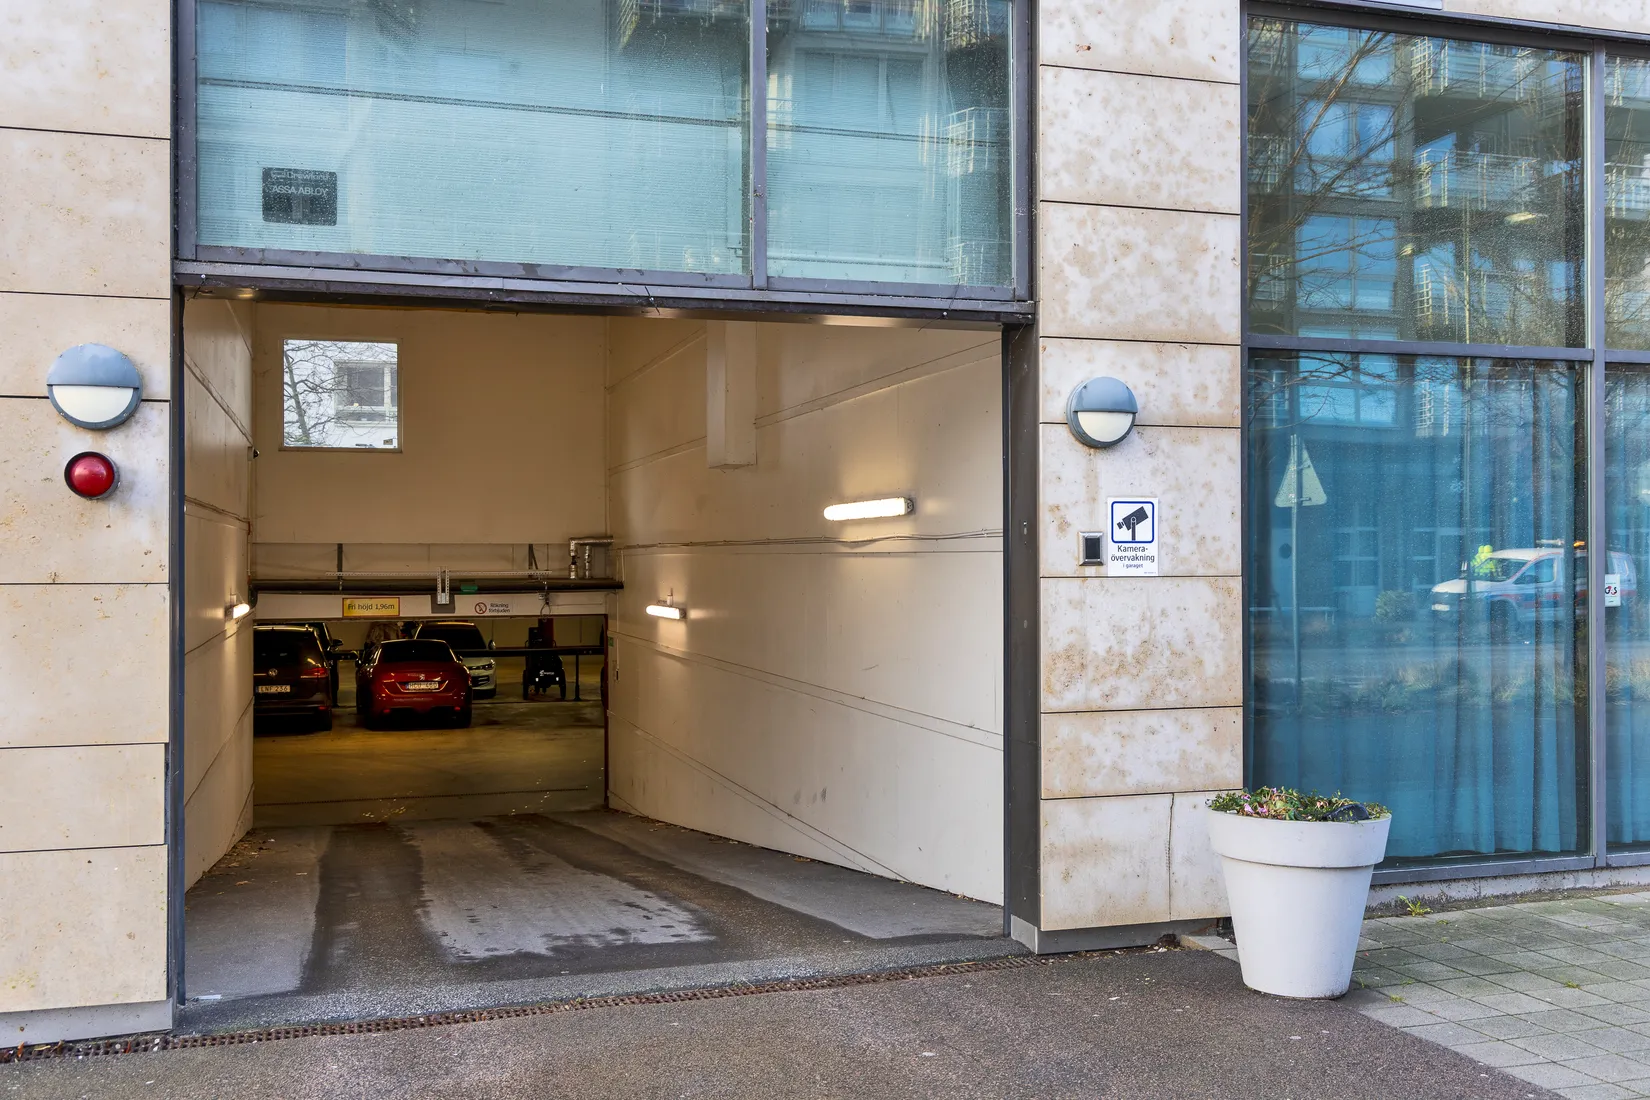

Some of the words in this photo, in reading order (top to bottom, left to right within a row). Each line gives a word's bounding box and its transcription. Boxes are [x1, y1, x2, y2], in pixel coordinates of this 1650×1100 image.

[272, 185, 298, 195] ASSA
[298, 186, 328, 197] ABLOY
[1117, 544, 1148, 553] Kamera-
[1110, 553, 1155, 563] övervakning
[357, 603, 373, 612] höjd
[375, 603, 395, 611] 1,96m
